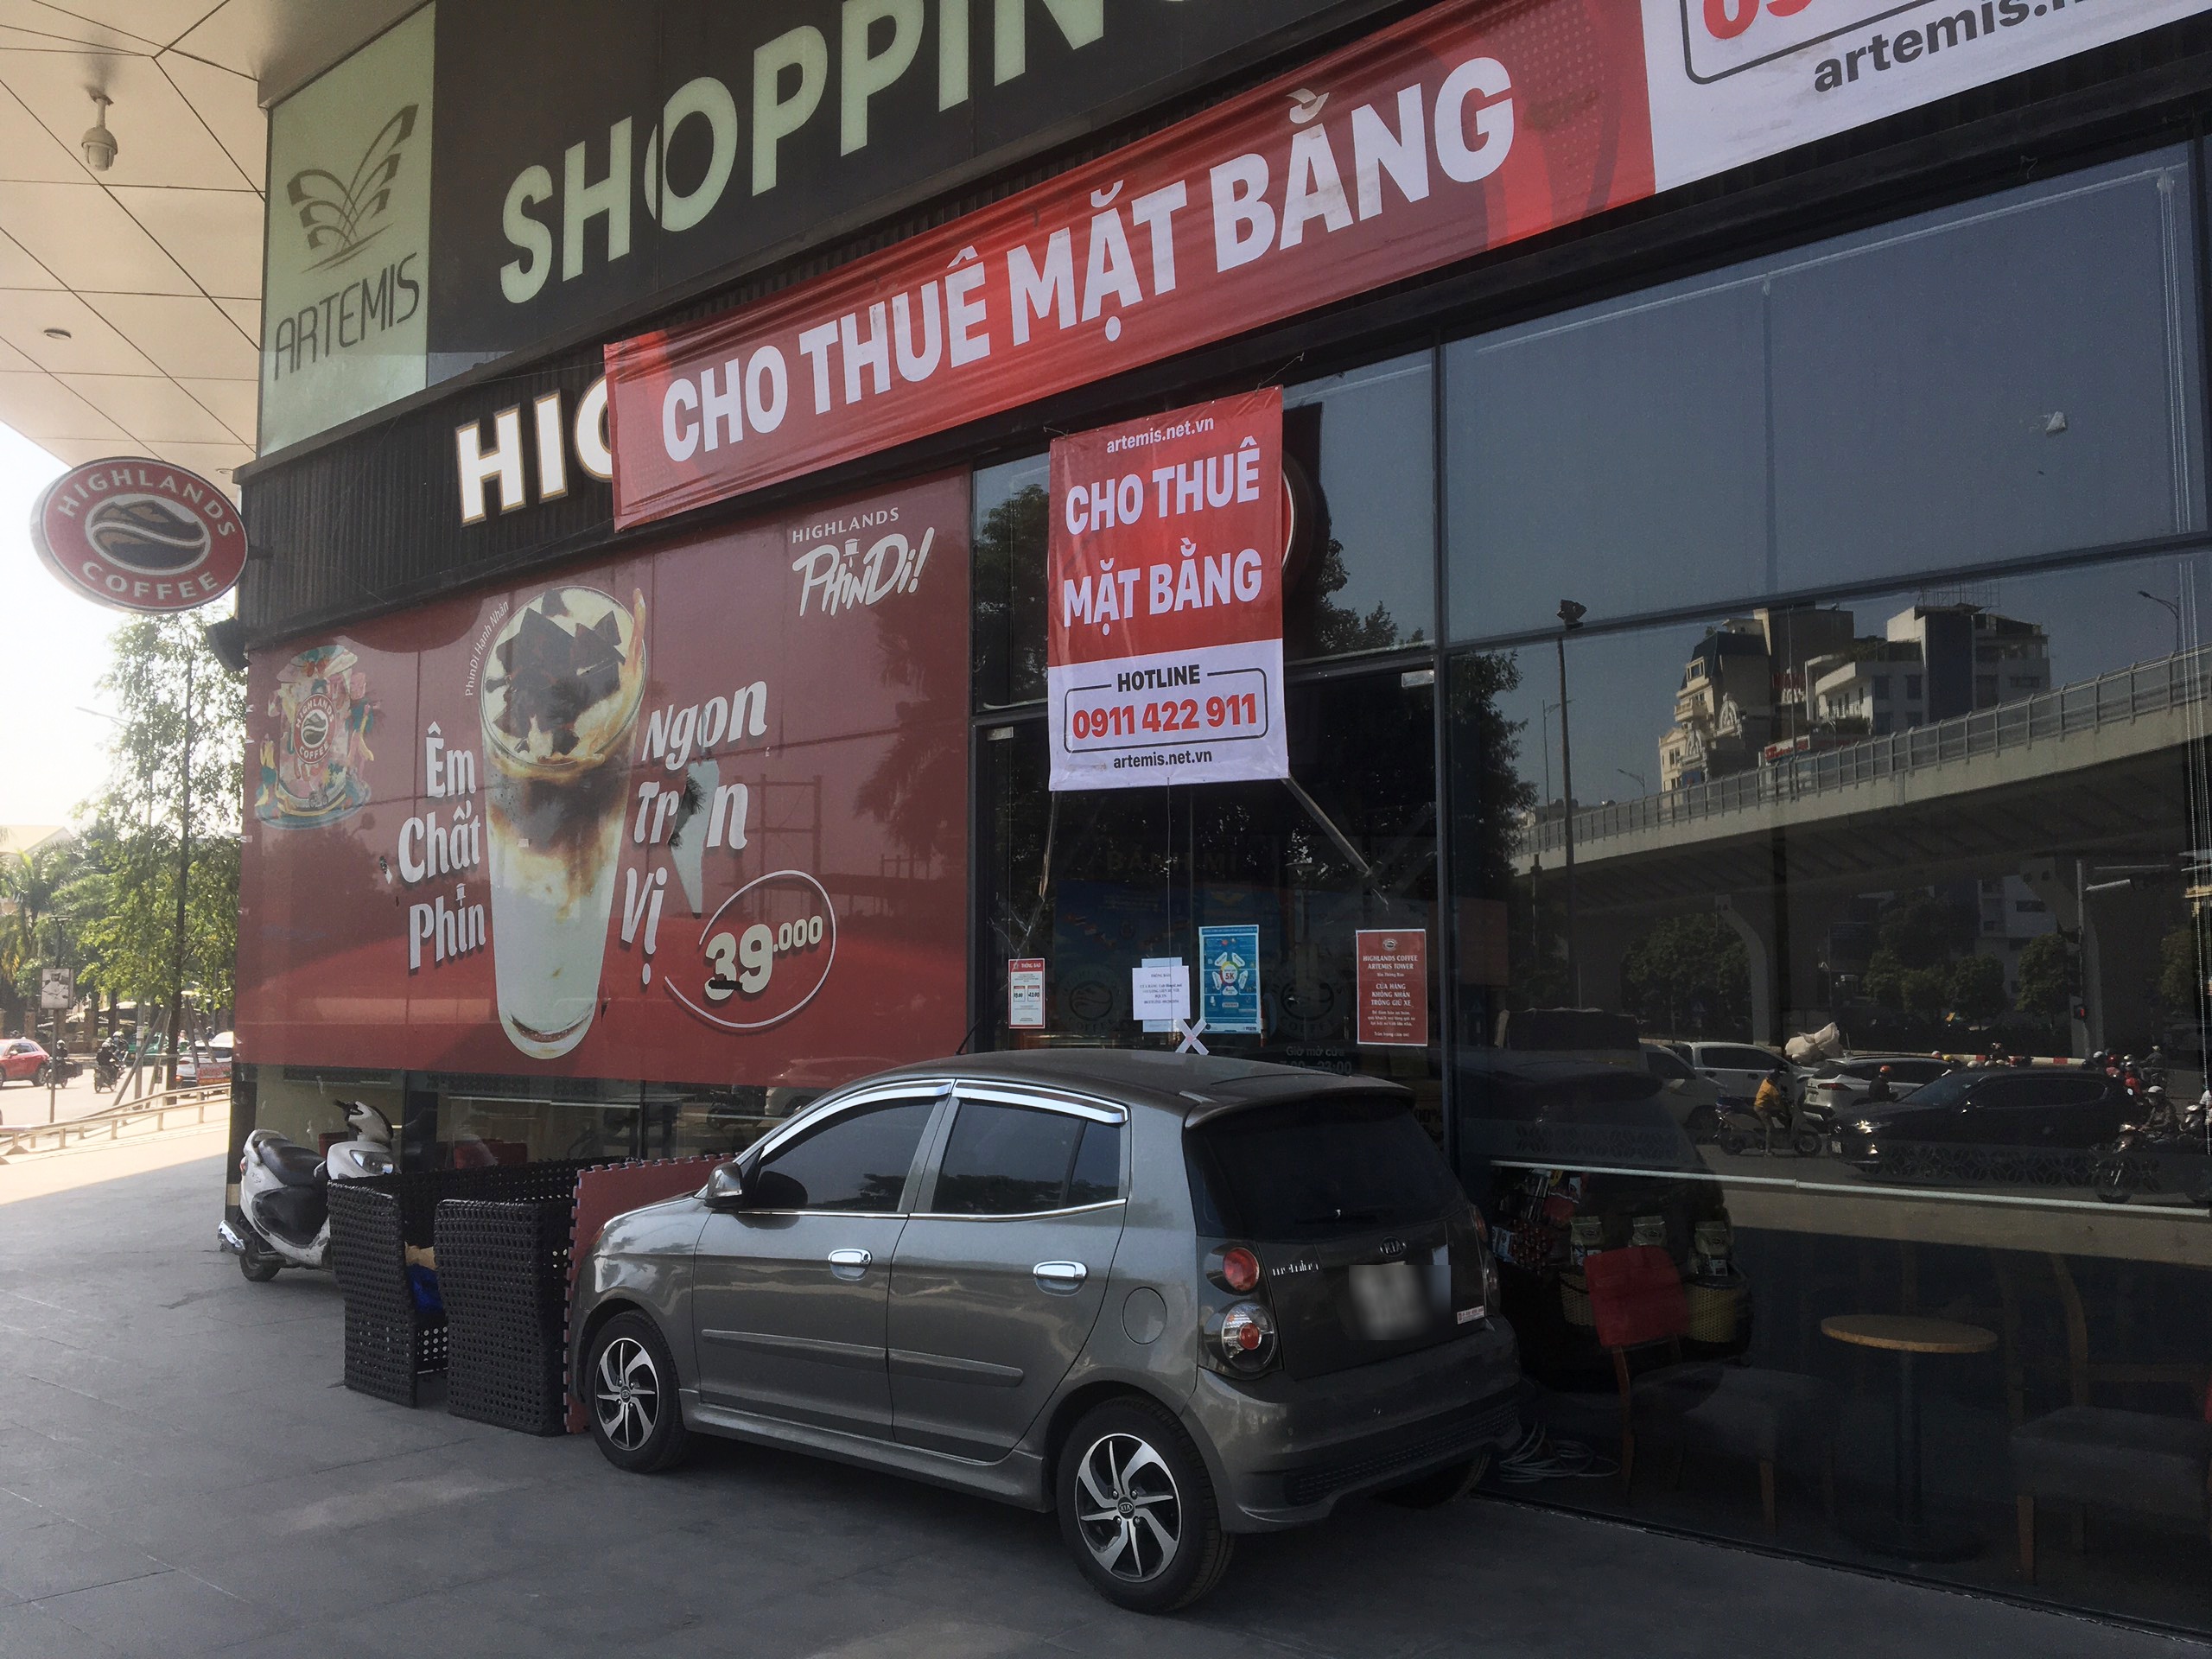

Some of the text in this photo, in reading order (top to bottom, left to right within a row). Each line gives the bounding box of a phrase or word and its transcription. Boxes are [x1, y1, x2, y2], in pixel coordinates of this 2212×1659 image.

[1815, 0, 2066, 92] artemis.
[662, 56, 1515, 461] CHO THUÊ MẶT BẰNG
[274, 251, 420, 380] ARTEMIS
[1106, 416, 1214, 454] artemis.net.vn
[57, 467, 236, 537] HIGHLANDS
[1065, 435, 1260, 535] CHO THUÊ
[792, 506, 899, 543] HIGHLANDS
[81, 561, 218, 601] COFFEE
[1064, 537, 1262, 636] MẶT BẰNG
[296, 697, 334, 728] HIGHLANDS
[1117, 664, 1200, 692] HOTLINE
[299, 741, 330, 759] COFFEE
[641, 680, 767, 771] Ngon
[1072, 693, 1256, 739] 0911 422 911
[426, 721, 476, 798] Êm
[1113, 749, 1212, 768] artemis.net.vn
[398, 800, 481, 883] Chất
[633, 780, 749, 850] Trn
[621, 866, 668, 984] Vị
[1384, 1241, 1402, 1255] KIA
